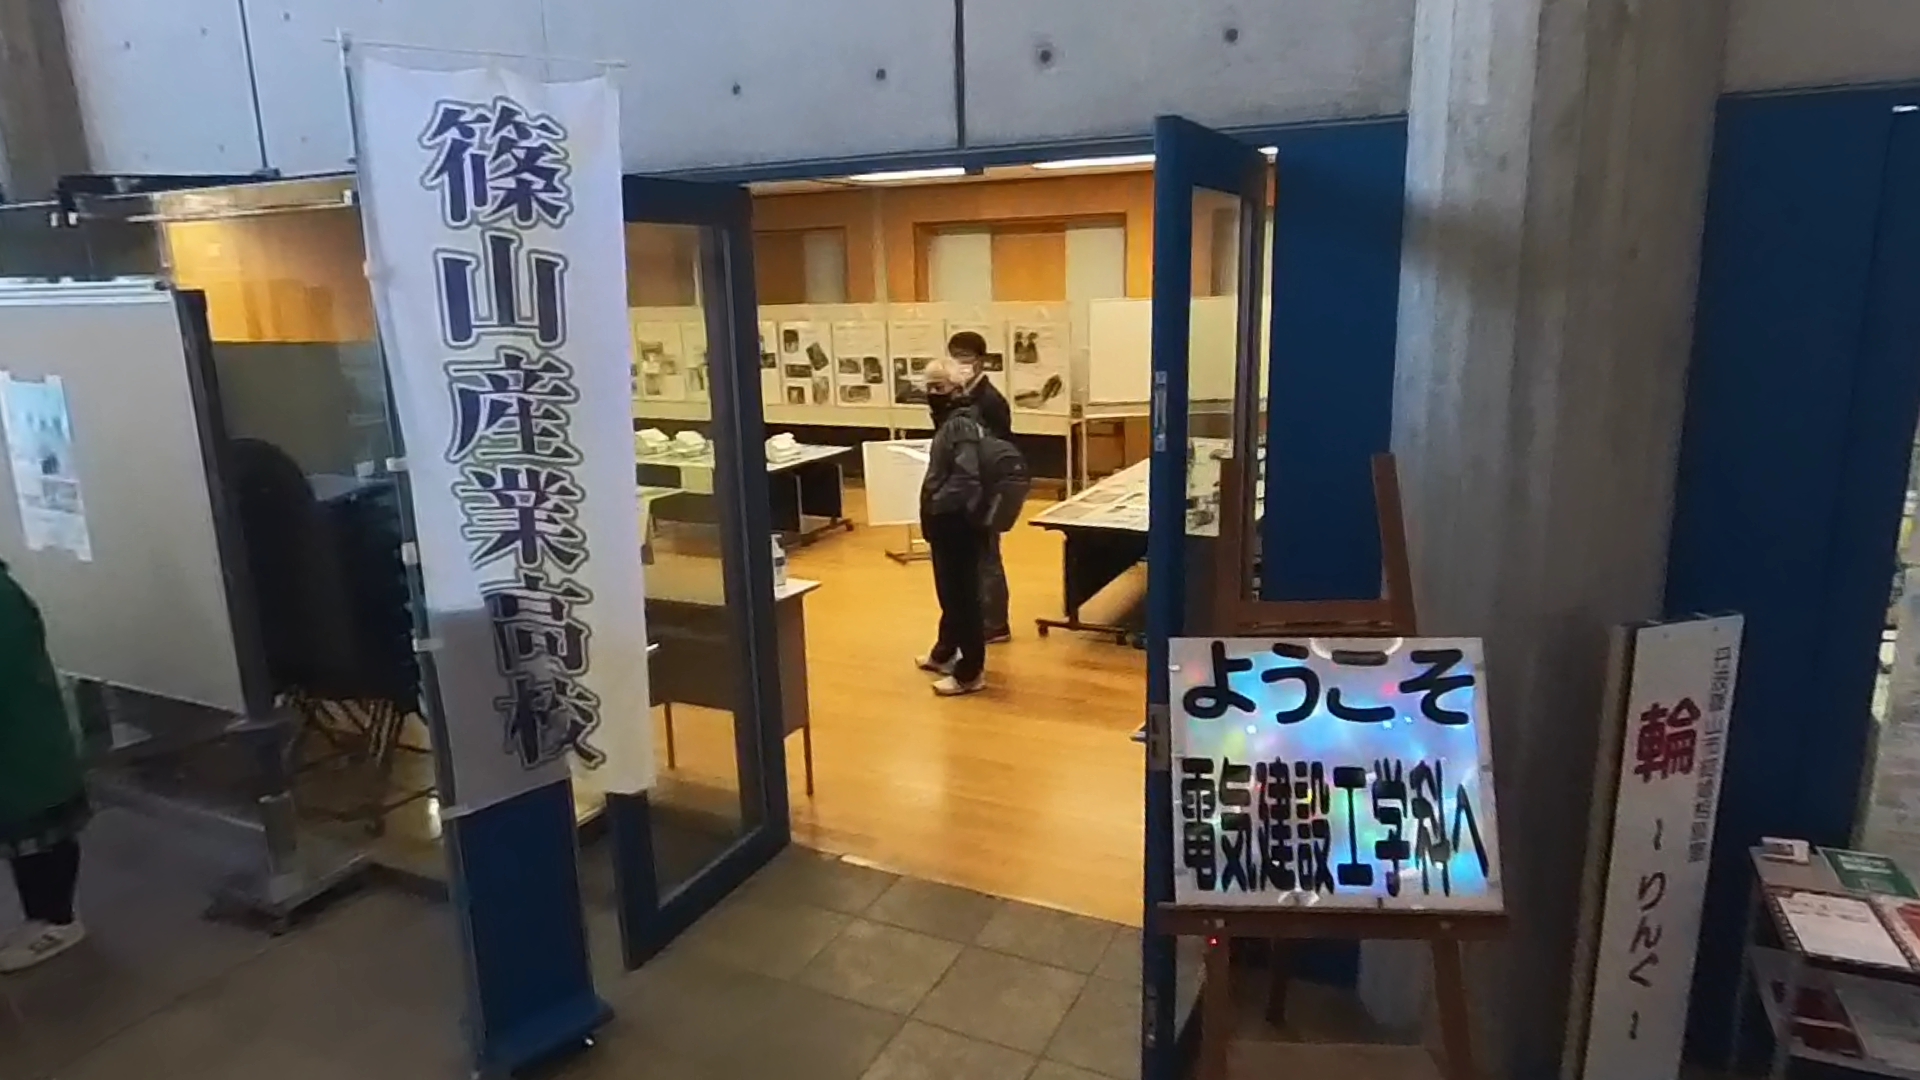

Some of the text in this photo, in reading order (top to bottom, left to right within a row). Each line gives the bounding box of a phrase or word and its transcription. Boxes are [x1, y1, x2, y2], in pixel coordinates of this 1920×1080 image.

[420, 97, 606, 769] 篠山産業高校
[1182, 641, 1475, 725] ようこそ
[1633, 697, 1701, 784] 輪
[1181, 756, 1489, 897] 電気建設工学科へ
